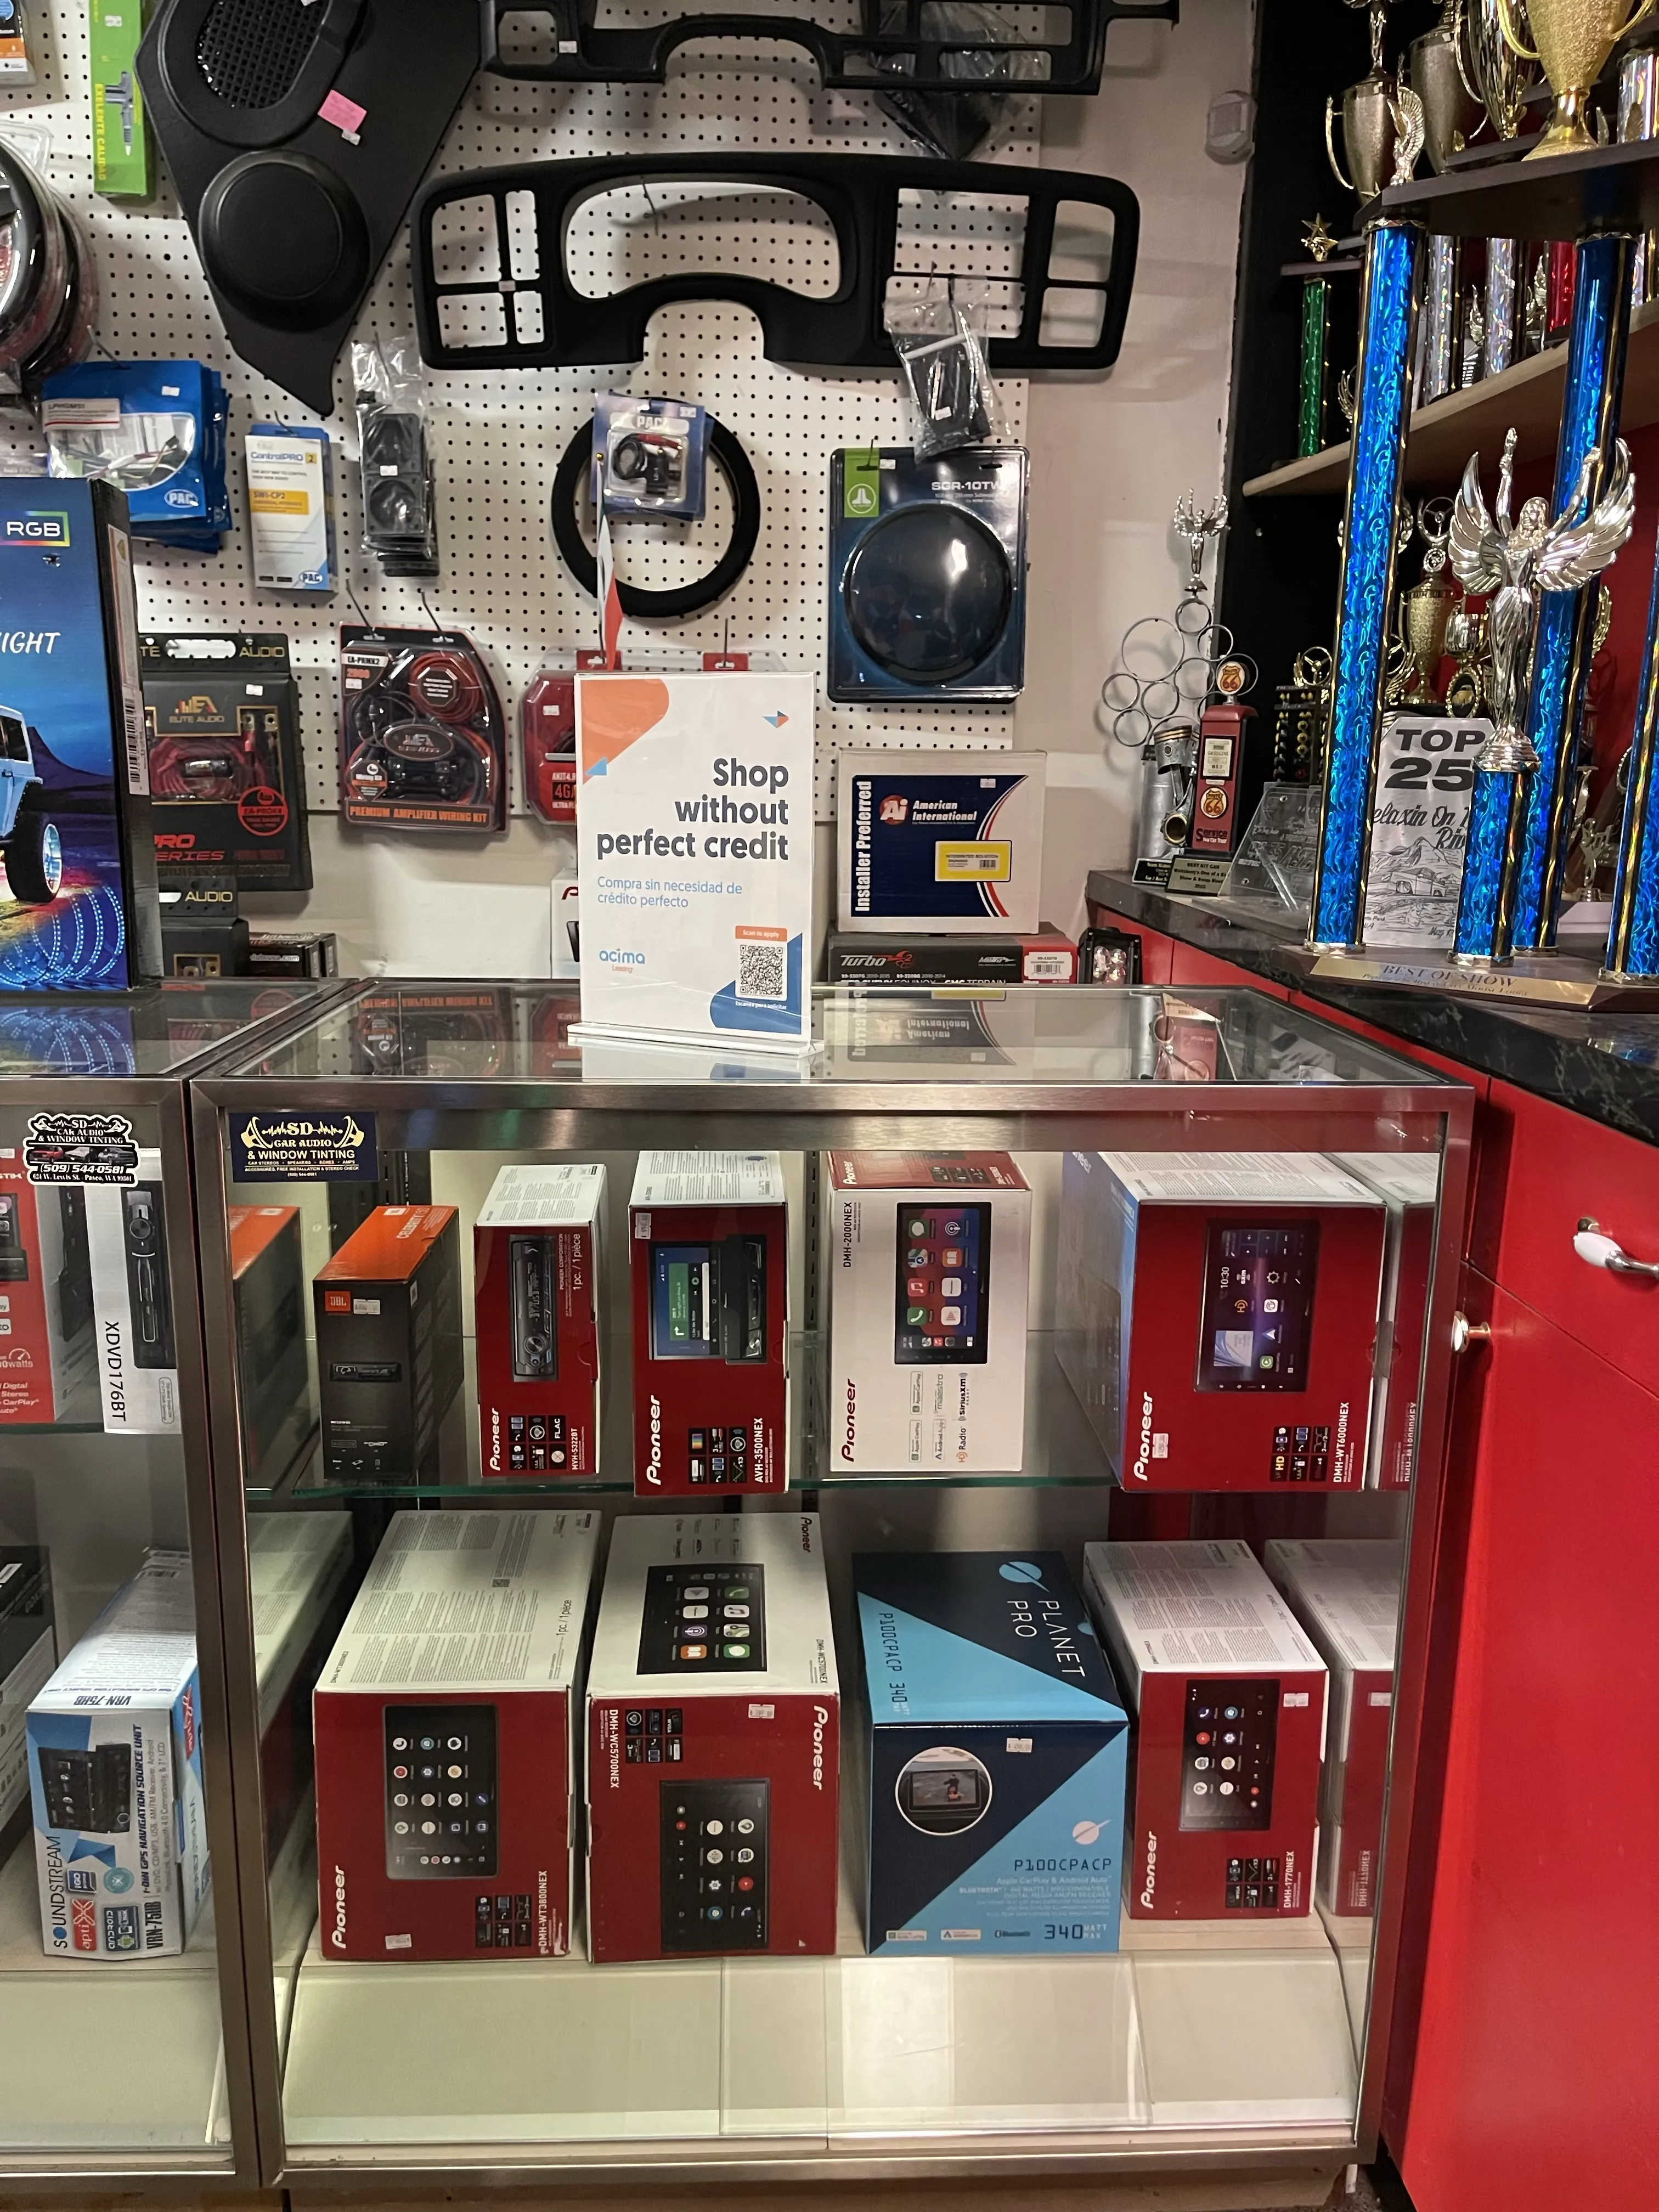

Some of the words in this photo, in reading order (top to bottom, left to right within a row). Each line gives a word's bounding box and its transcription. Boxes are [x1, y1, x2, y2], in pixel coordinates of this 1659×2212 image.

[169, 492, 194, 505] PAC
[7, 522, 60, 537] RGB
[301, 573, 321, 583] PAC
[0, 632, 60, 654] IGHT
[240, 646, 285, 657] AUDIO
[1222, 675, 1239, 689] 66
[1396, 729, 1486, 752] TOP
[713, 758, 789, 794] Shop
[1384, 758, 1474, 791] 25
[349, 805, 390, 818] PREMIUM
[393, 808, 438, 821] AMPLIFIER
[438, 810, 471, 822] WIRING
[472, 812, 487, 823] KIT
[675, 794, 788, 825] without
[856, 781, 872, 849] Preferred
[912, 811, 977, 821] International
[913, 800, 958, 811] American
[1206, 802, 1222, 813] 66
[1431, 806, 1456, 827] On
[597, 828, 695, 860] perfect
[704, 831, 788, 860] credit
[1196, 828, 1228, 842] Service
[597, 877, 642, 890] Compra
[645, 879, 661, 890] sin
[664, 881, 723, 894] necesidad
[726, 882, 742, 895] de
[855, 851, 871, 911] Installer
[185, 891, 233, 902] AUDIO
[597, 892, 637, 905] crédito
[640, 895, 689, 908] perfecto
[599, 948, 646, 964] acima
[840, 955, 886, 967] Turbo
[1383, 964, 1428, 978] BEST
[1431, 970, 1455, 980] OF
[1460, 974, 1518, 988] SHOW
[71, 1119, 88, 1128] SD
[287, 1122, 313, 1136] SD
[88, 1136, 123, 1144] TINTING
[299, 1139, 332, 1147] AUDIO
[247, 1151, 256, 1160] &
[258, 1150, 307, 1159] WINDOW
[309, 1150, 355, 1159] TINTING
[40, 1164, 70, 1173] (509)
[72, 1165, 125, 1173] 544-0581
[843, 1159, 857, 1184] Pioneer
[844, 1202, 852, 1267] DMH-2000NEX
[1220, 1267, 1230, 1289] 10:30
[330, 1296, 346, 1306] JBL
[105, 1321, 127, 1422] XDVD176BT
[841, 1379, 856, 1462] Pioneer
[489, 1408, 500, 1471] Pioneer
[647, 1395, 662, 1485] Pioneer
[1133, 1391, 1153, 1481] Pioneer
[1333, 1402, 1350, 1483] DMH-WT6000NEX
[754, 1417, 764, 1483] AVH-3500NEX
[1276, 1456, 1285, 1470] HD
[800, 1516, 812, 1553] Pioneer
[1007, 1600, 1037, 1638] PRO
[879, 1612, 902, 1672] P100CPACP
[1038, 1600, 1086, 1677] PLANET
[74, 1695, 132, 1706] VRN-75HB
[889, 1682, 908, 1703] 340
[133, 1724, 142, 1748] UNIT
[146, 1739, 155, 1765] Android
[609, 1709, 619, 1788] DMH-WC5700NEX
[813, 1705, 828, 1790] Pioneer
[134, 1751, 144, 1788] SOURCE
[137, 1790, 148, 1849] NAVIGATION
[140, 1851, 148, 1870] GPS
[1014, 1858, 1111, 1871] P100CPACP
[1141, 1831, 1156, 1909] Pioneer
[996, 1877, 1018, 1886] Apple
[1019, 1877, 1050, 1886] CarPlay
[1283, 1850, 1295, 1908] DMH-1770NEX
[331, 1865, 347, 1949] Pioneer
[106, 1910, 115, 1949] ANDROID
[144, 1901, 163, 1949] VRN-75HB
[1044, 1924, 1083, 1939] 340
